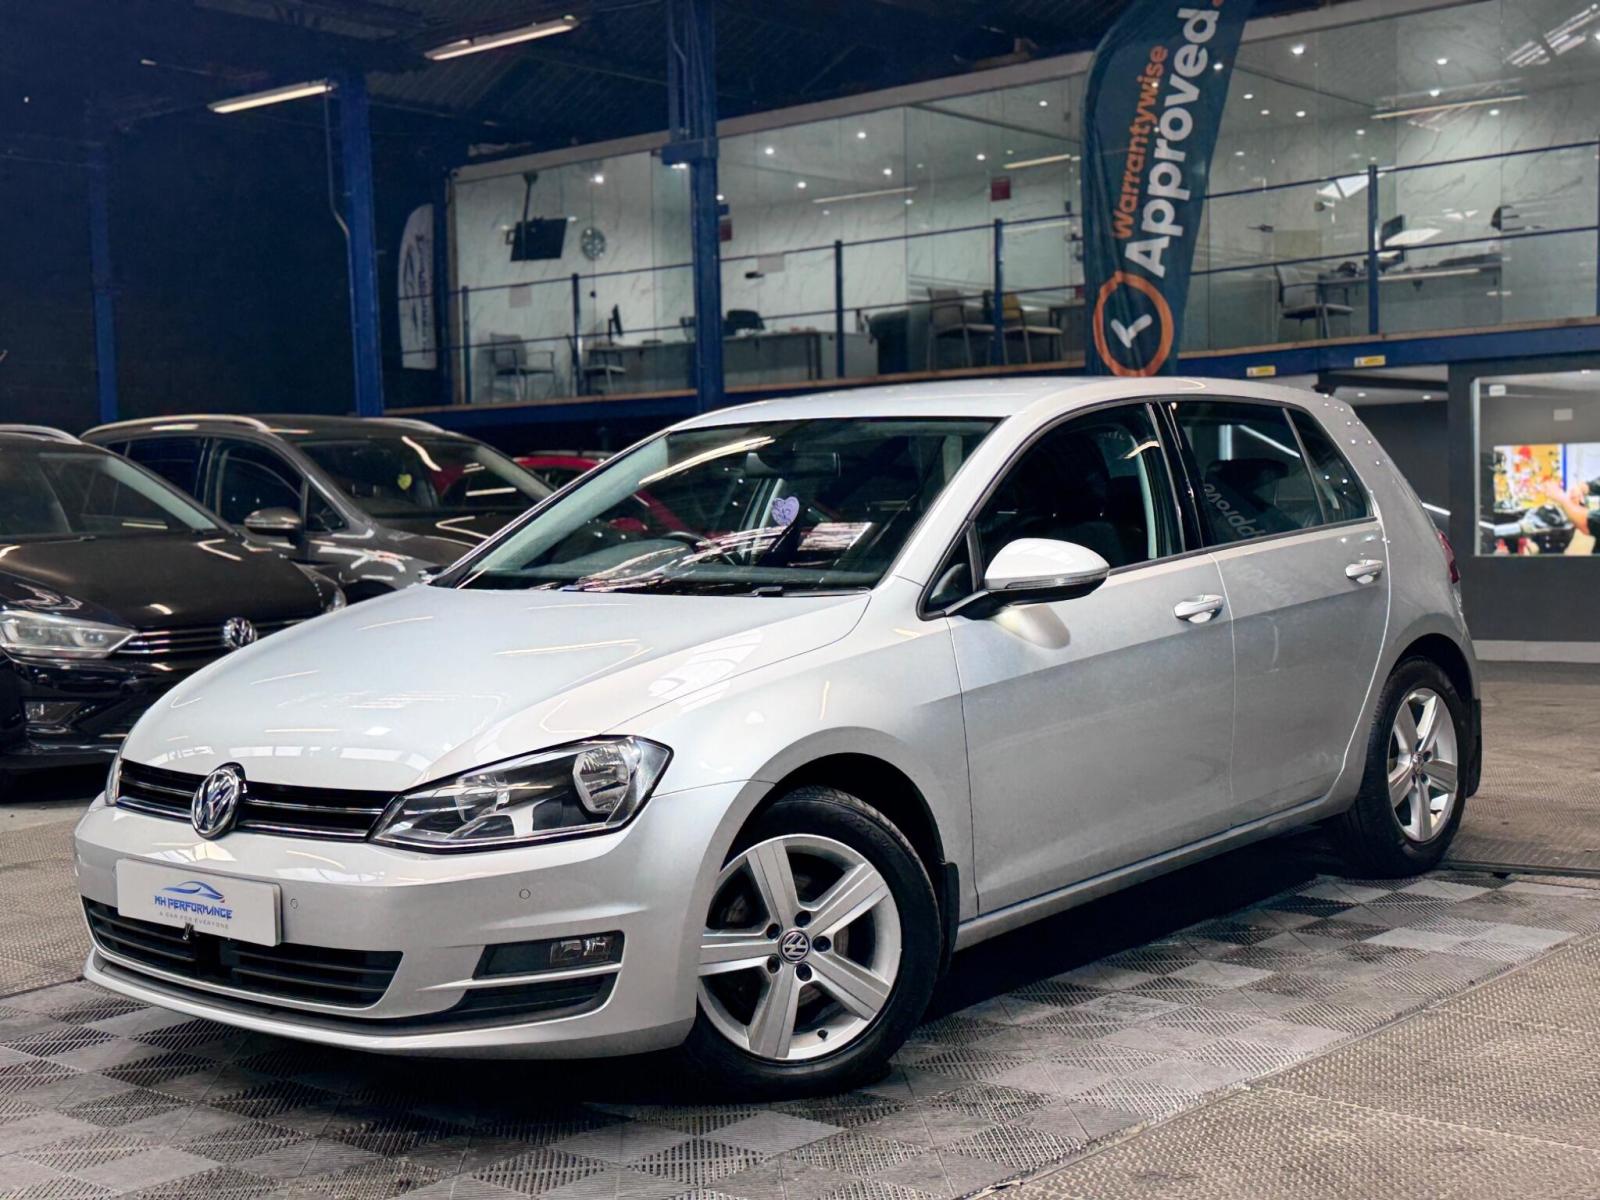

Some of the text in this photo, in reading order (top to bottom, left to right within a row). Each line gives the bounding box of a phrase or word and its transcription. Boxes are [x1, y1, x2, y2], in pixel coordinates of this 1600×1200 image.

[1113, 45, 1169, 240] Warrantywise
[154, 895, 233, 920] MH PERFORMANCE
[165, 912, 178, 920] CAR
[180, 914, 193, 922] FOR
[195, 918, 229, 930] EVERYONE
